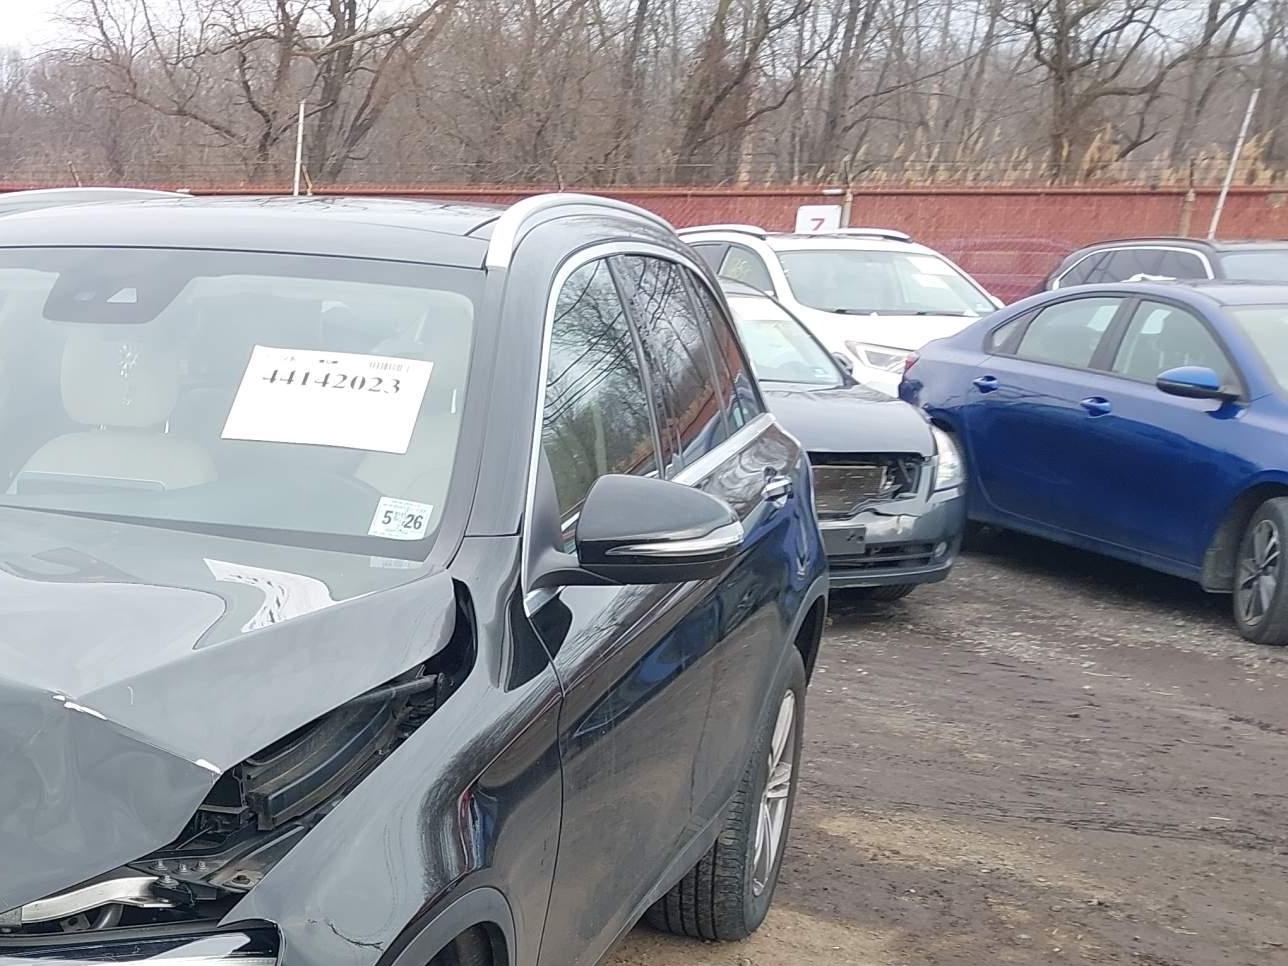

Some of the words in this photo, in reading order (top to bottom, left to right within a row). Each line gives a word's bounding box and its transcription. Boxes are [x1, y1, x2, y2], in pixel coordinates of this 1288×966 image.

[262, 369, 401, 394] 44142023
[382, 510, 394, 525] 5
[403, 513, 423, 530] 26
